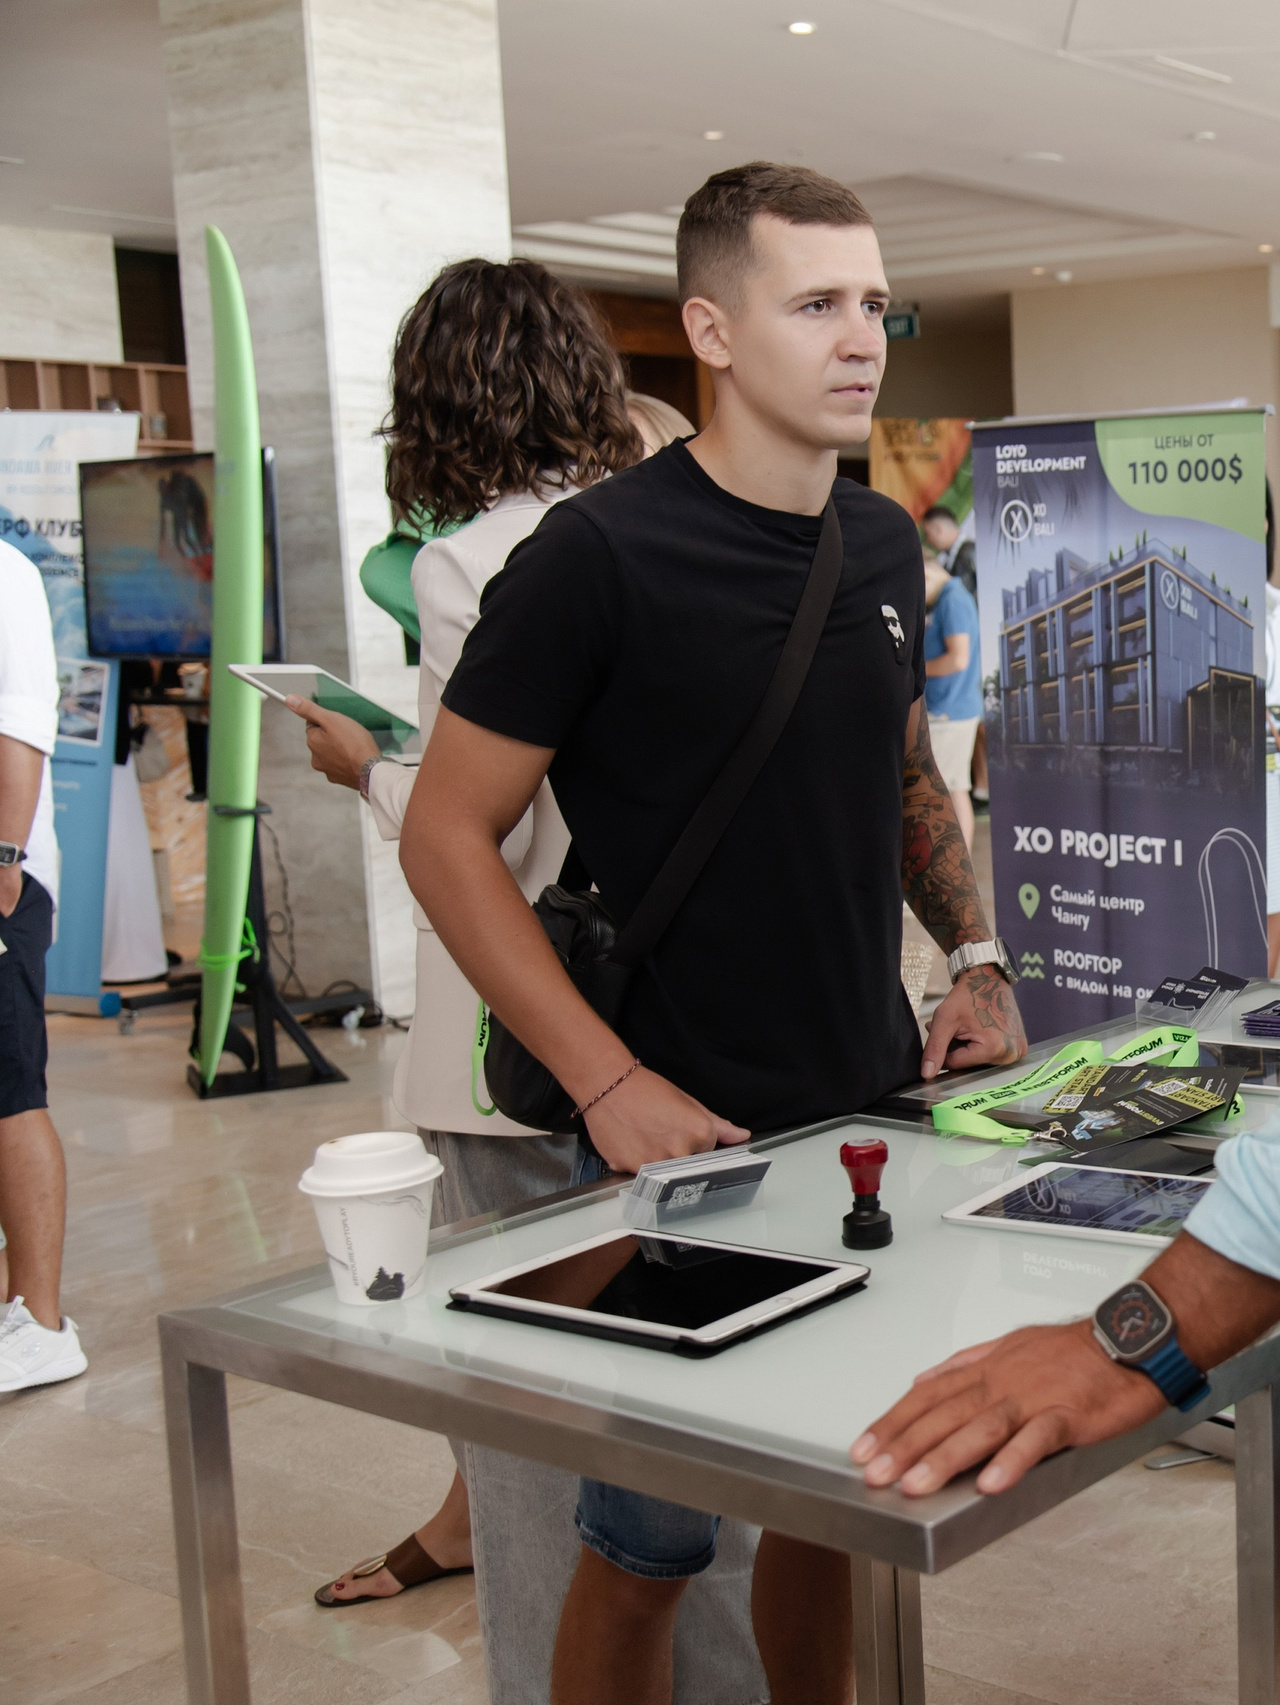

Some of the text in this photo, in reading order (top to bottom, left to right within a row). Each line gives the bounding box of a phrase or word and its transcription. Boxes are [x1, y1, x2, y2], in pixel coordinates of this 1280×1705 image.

[995, 444, 1027, 460] LOYO
[1154, 434, 1214, 450] ЦЕНЫ ОТ
[996, 455, 1086, 475] DEVELOPMENT
[1128, 453, 1243, 485] 110 000$
[1013, 825, 1053, 854] XO
[1060, 828, 1167, 868] PROJECT
[1050, 884, 1145, 916] Самый центр
[1051, 905, 1090, 932] Чангу
[1054, 948, 1123, 975] ROOFTOP
[1066, 977, 1109, 996] видом
[1113, 983, 1132, 998] на
